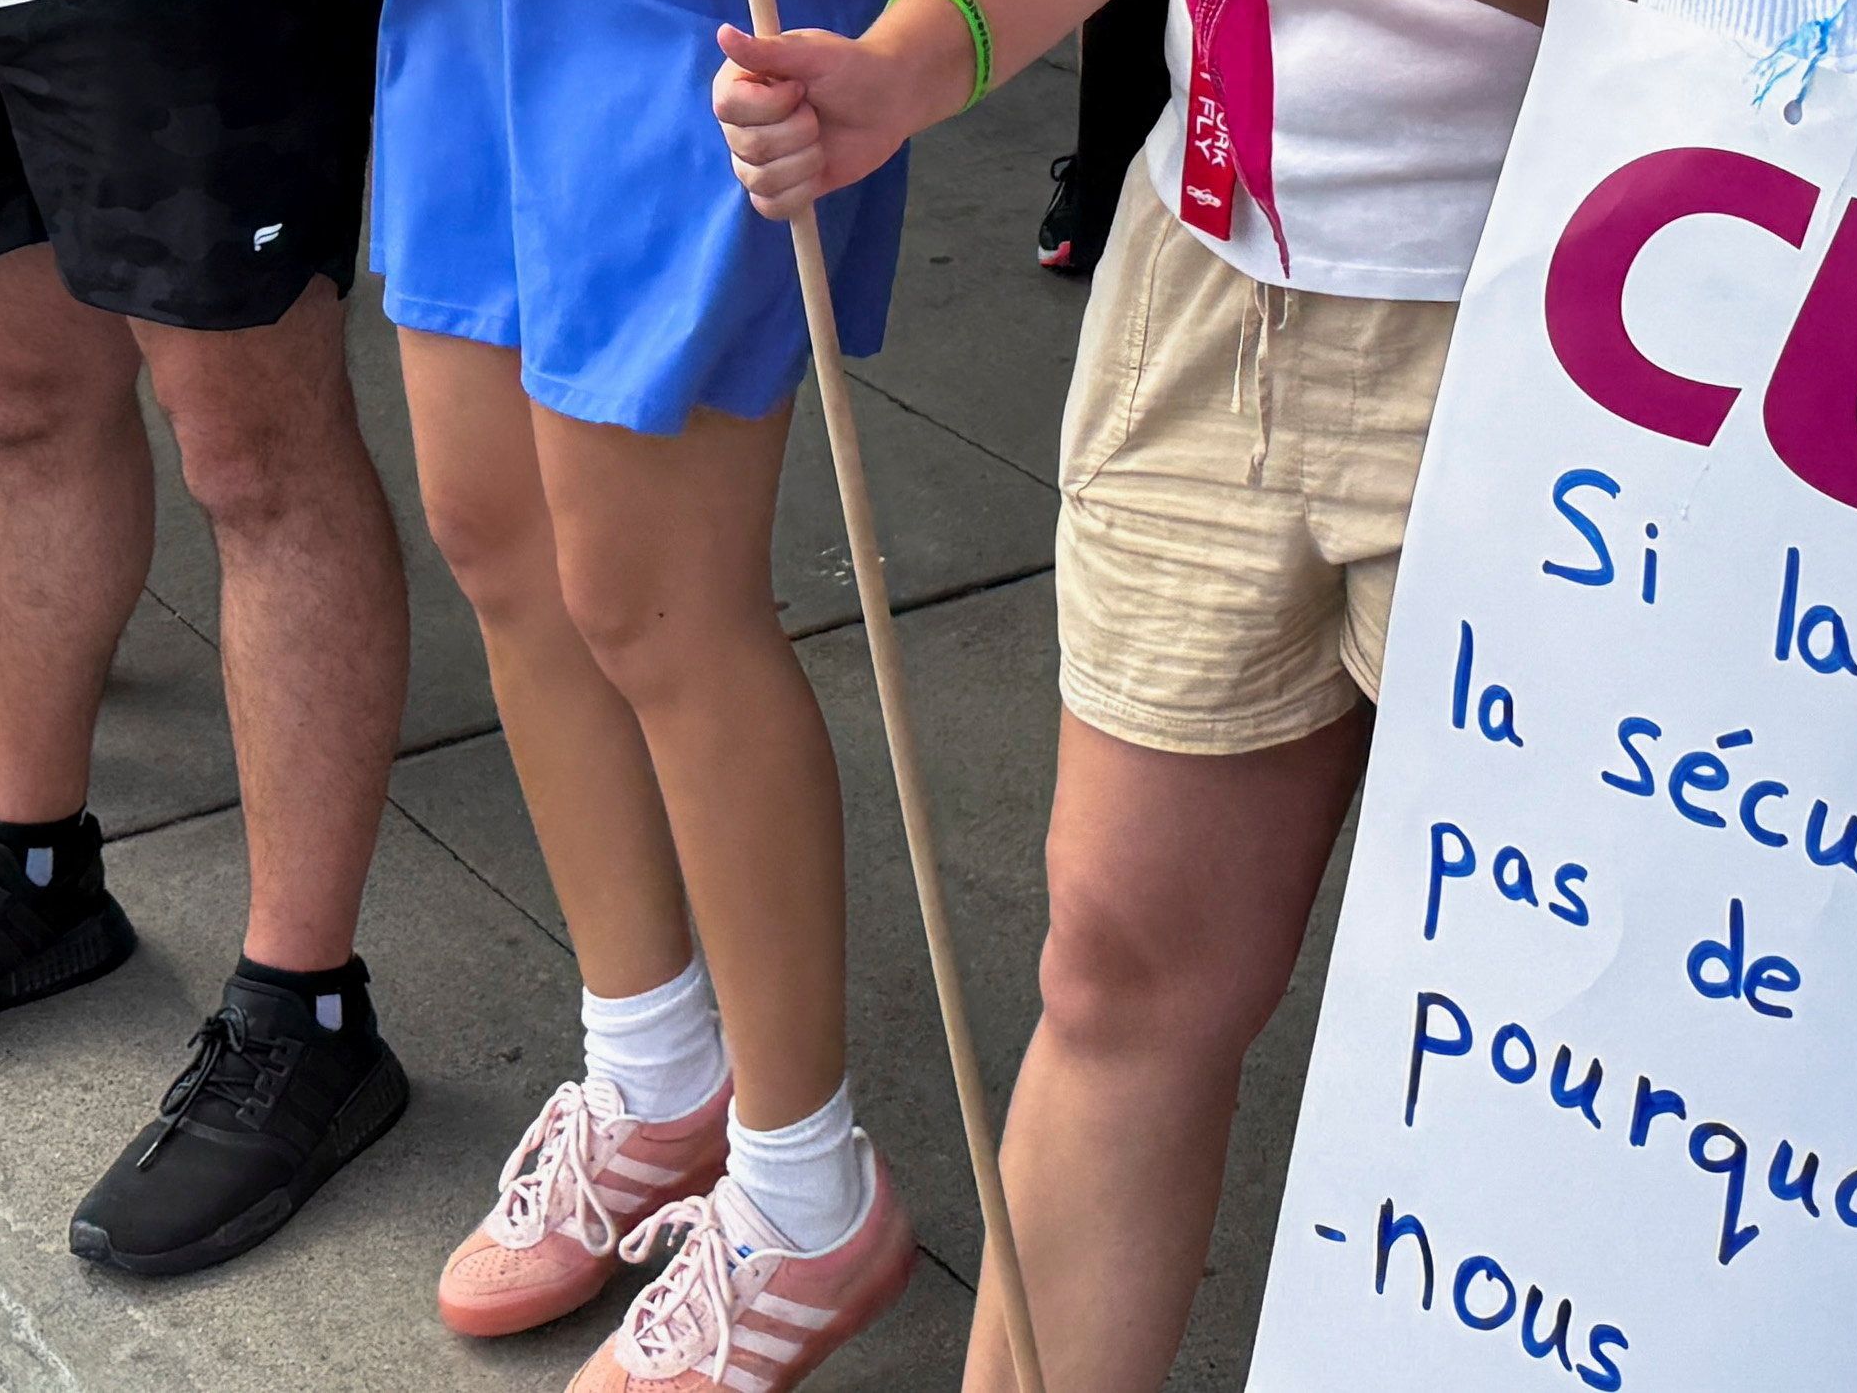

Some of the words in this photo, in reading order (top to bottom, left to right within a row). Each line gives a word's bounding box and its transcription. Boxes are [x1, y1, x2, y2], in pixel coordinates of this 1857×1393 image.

[1194, 95, 1216, 160] FLY
[1541, 468, 1660, 607] Si
[1452, 620, 1524, 748] la
[1425, 821, 1591, 939] pas
[1686, 897, 1802, 1019] de
